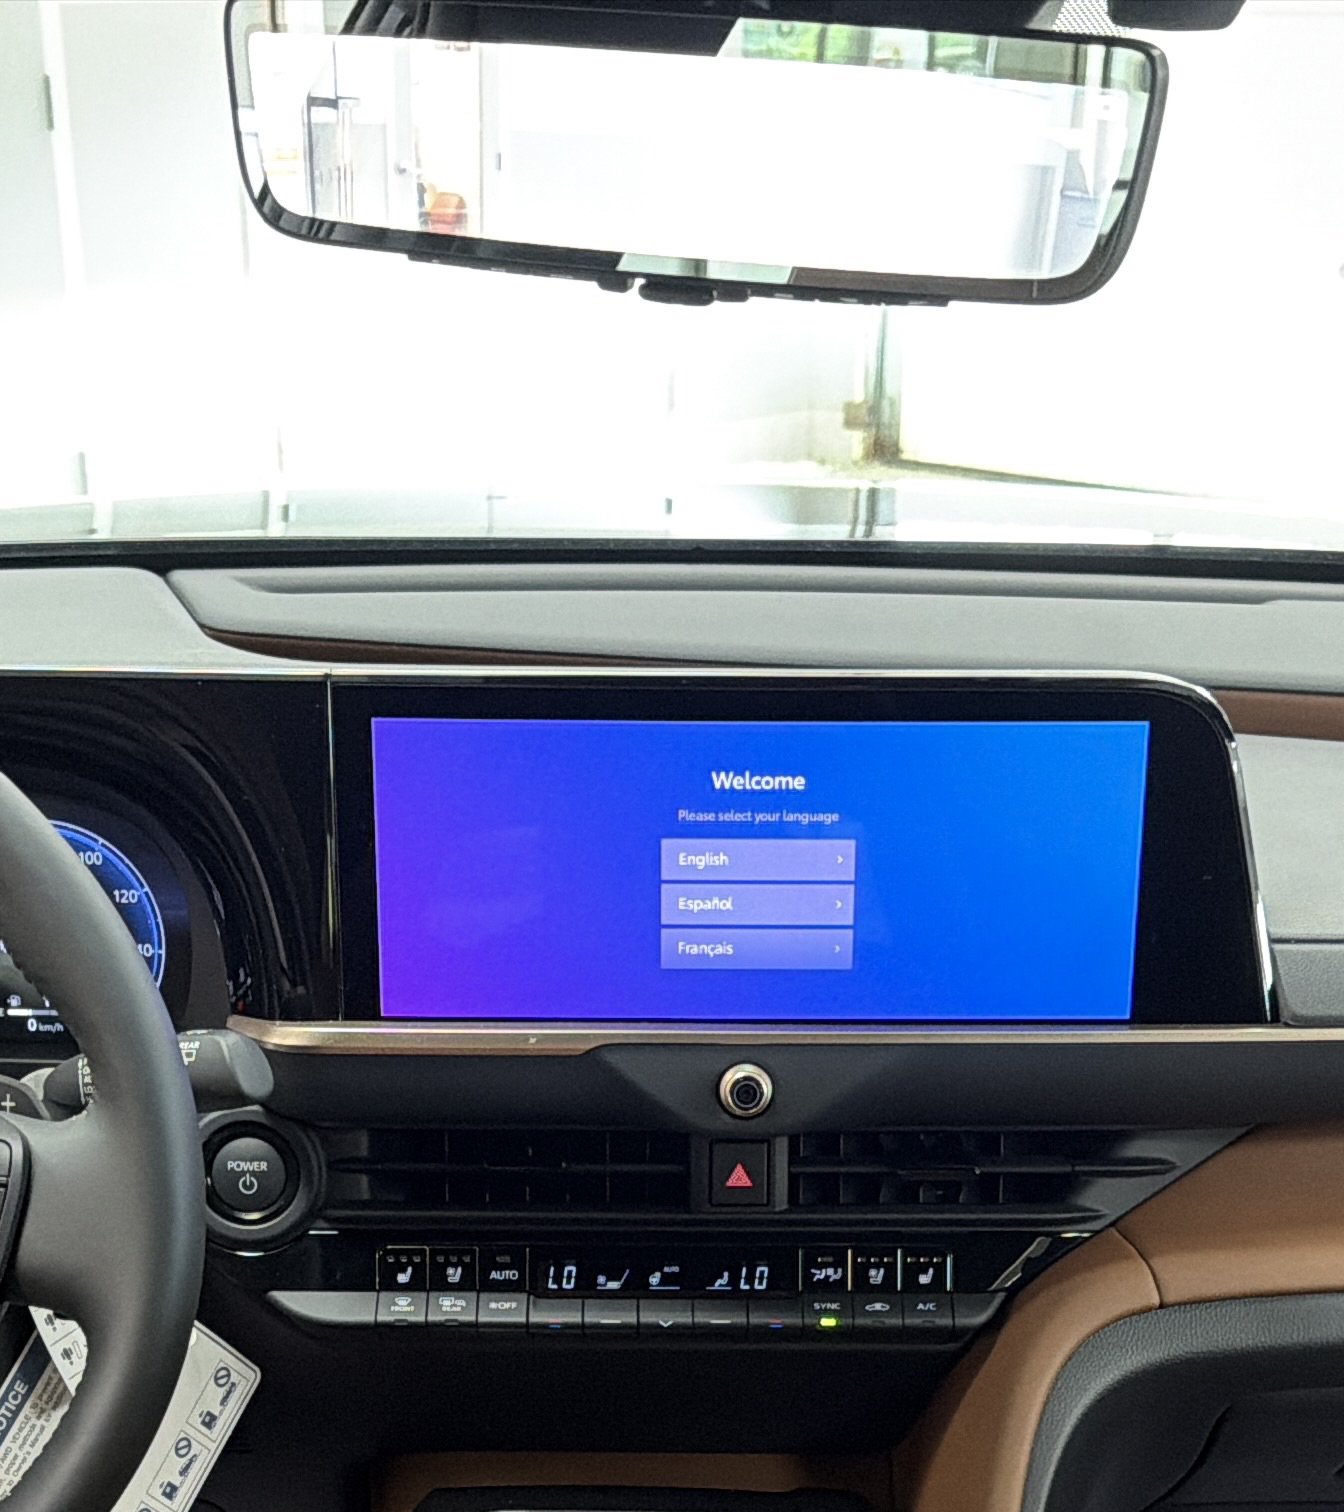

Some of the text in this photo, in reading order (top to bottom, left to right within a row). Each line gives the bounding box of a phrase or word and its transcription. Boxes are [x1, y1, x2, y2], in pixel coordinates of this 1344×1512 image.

[711, 770, 806, 790] Welcome
[677, 810, 839, 825] Please select your language
[79, 852, 103, 865] 100
[678, 852, 729, 869] English
[113, 890, 138, 903] 120
[678, 896, 733, 913] Español
[678, 941, 733, 957] Français
[27, 1019, 37, 1032] 0
[227, 1161, 268, 1172] POWER
[489, 1270, 519, 1281] AUTO
[497, 1302, 517, 1310] OFF
